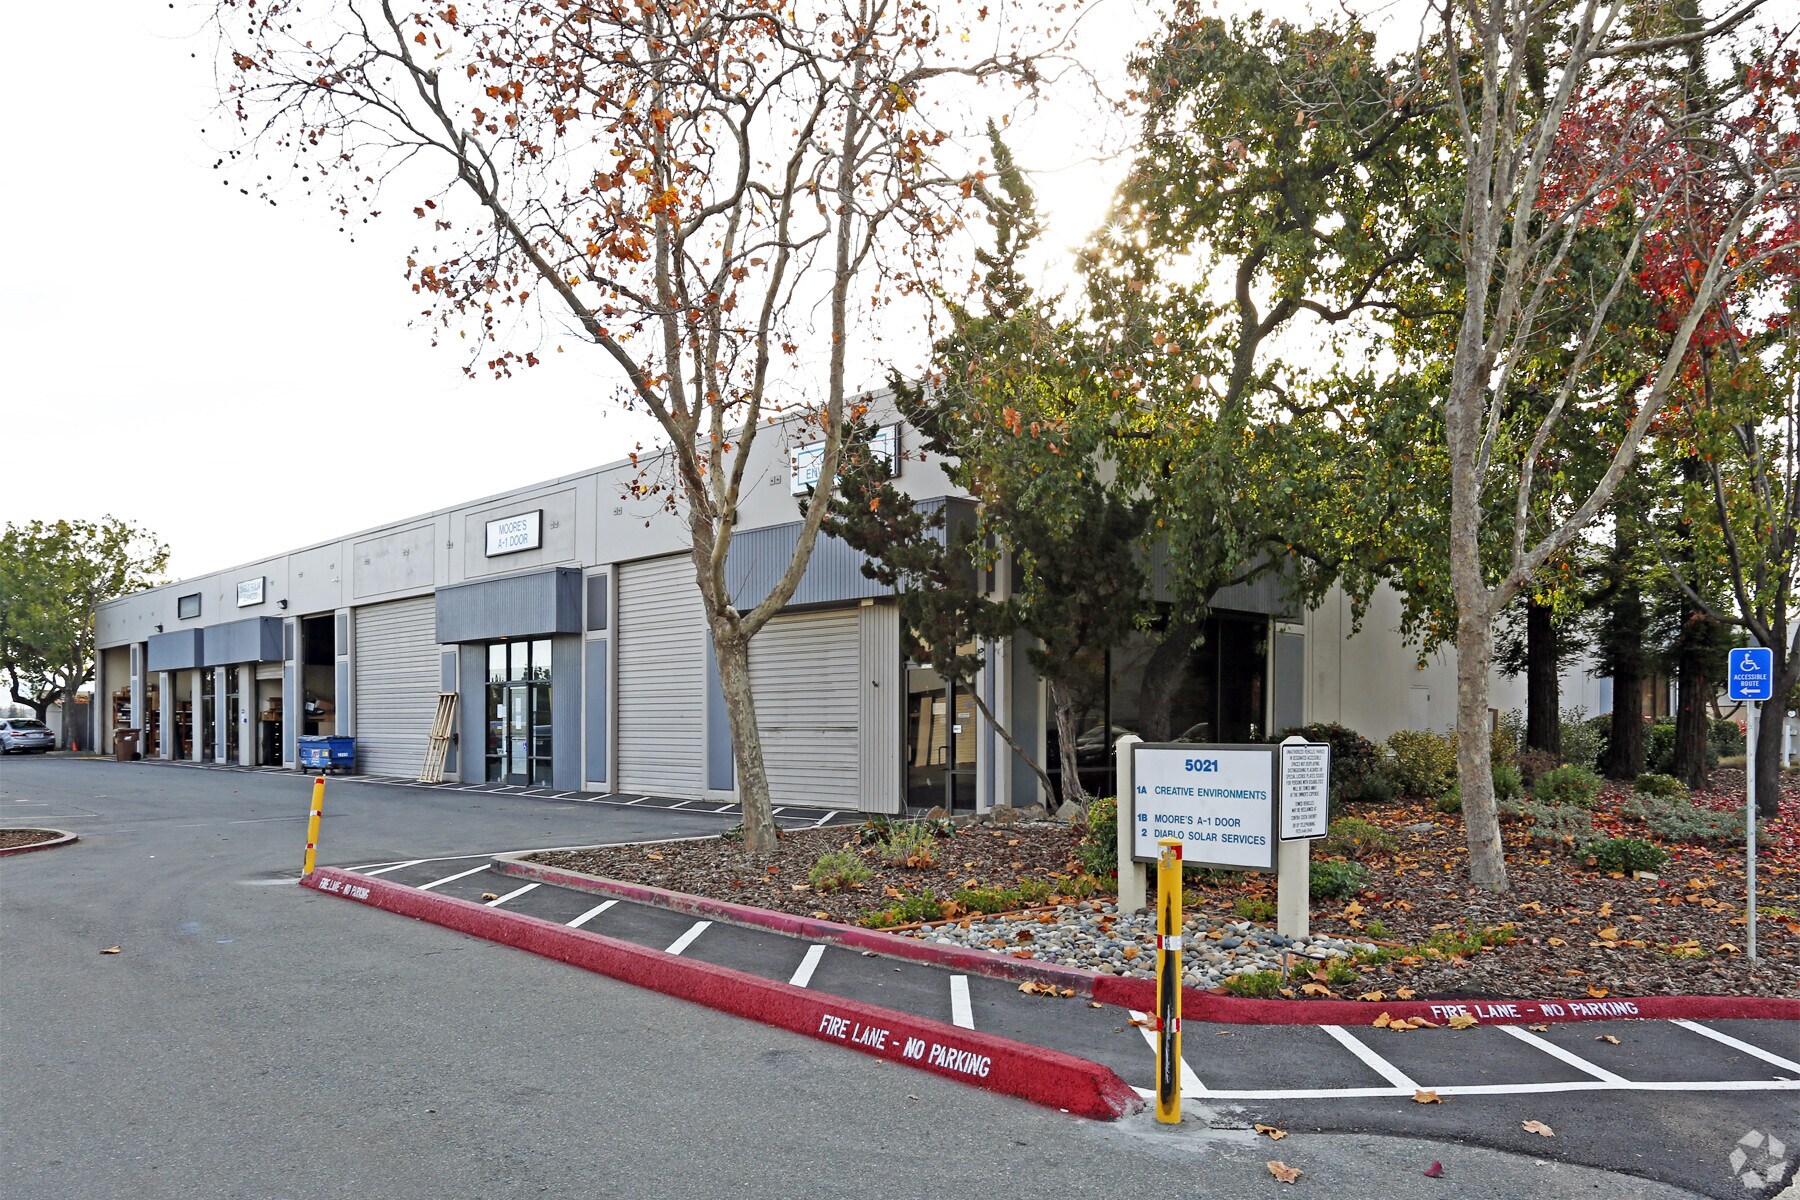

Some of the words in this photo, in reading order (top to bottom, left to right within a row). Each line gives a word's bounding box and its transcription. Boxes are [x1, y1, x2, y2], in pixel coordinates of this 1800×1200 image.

[510, 533, 528, 547] DOOR
[1185, 759, 1218, 772] 5021
[1137, 786, 1147, 794] 1A
[1154, 786, 1194, 796] CREATIVE
[1197, 788, 1267, 800] ENVIRONMENTS
[1154, 814, 1193, 824] MOORE'S
[1197, 817, 1211, 825] A-1
[1215, 818, 1241, 827] DOOR
[1141, 829, 1148, 837] 2
[1154, 829, 1185, 840] DIABLO
[1188, 831, 1217, 841] SOLAR
[1221, 834, 1266, 845] SERVICES
[1430, 1004, 1467, 1019] FIRE
[1474, 1004, 1522, 1018] LANE
[1539, 1003, 1565, 1017] NO
[1567, 1002, 1639, 1017] PARKING
[819, 1014, 851, 1039] FIRE
[852, 1022, 889, 1050] LANE
[902, 1036, 926, 1060] NO
[927, 1043, 991, 1078] PARKING
